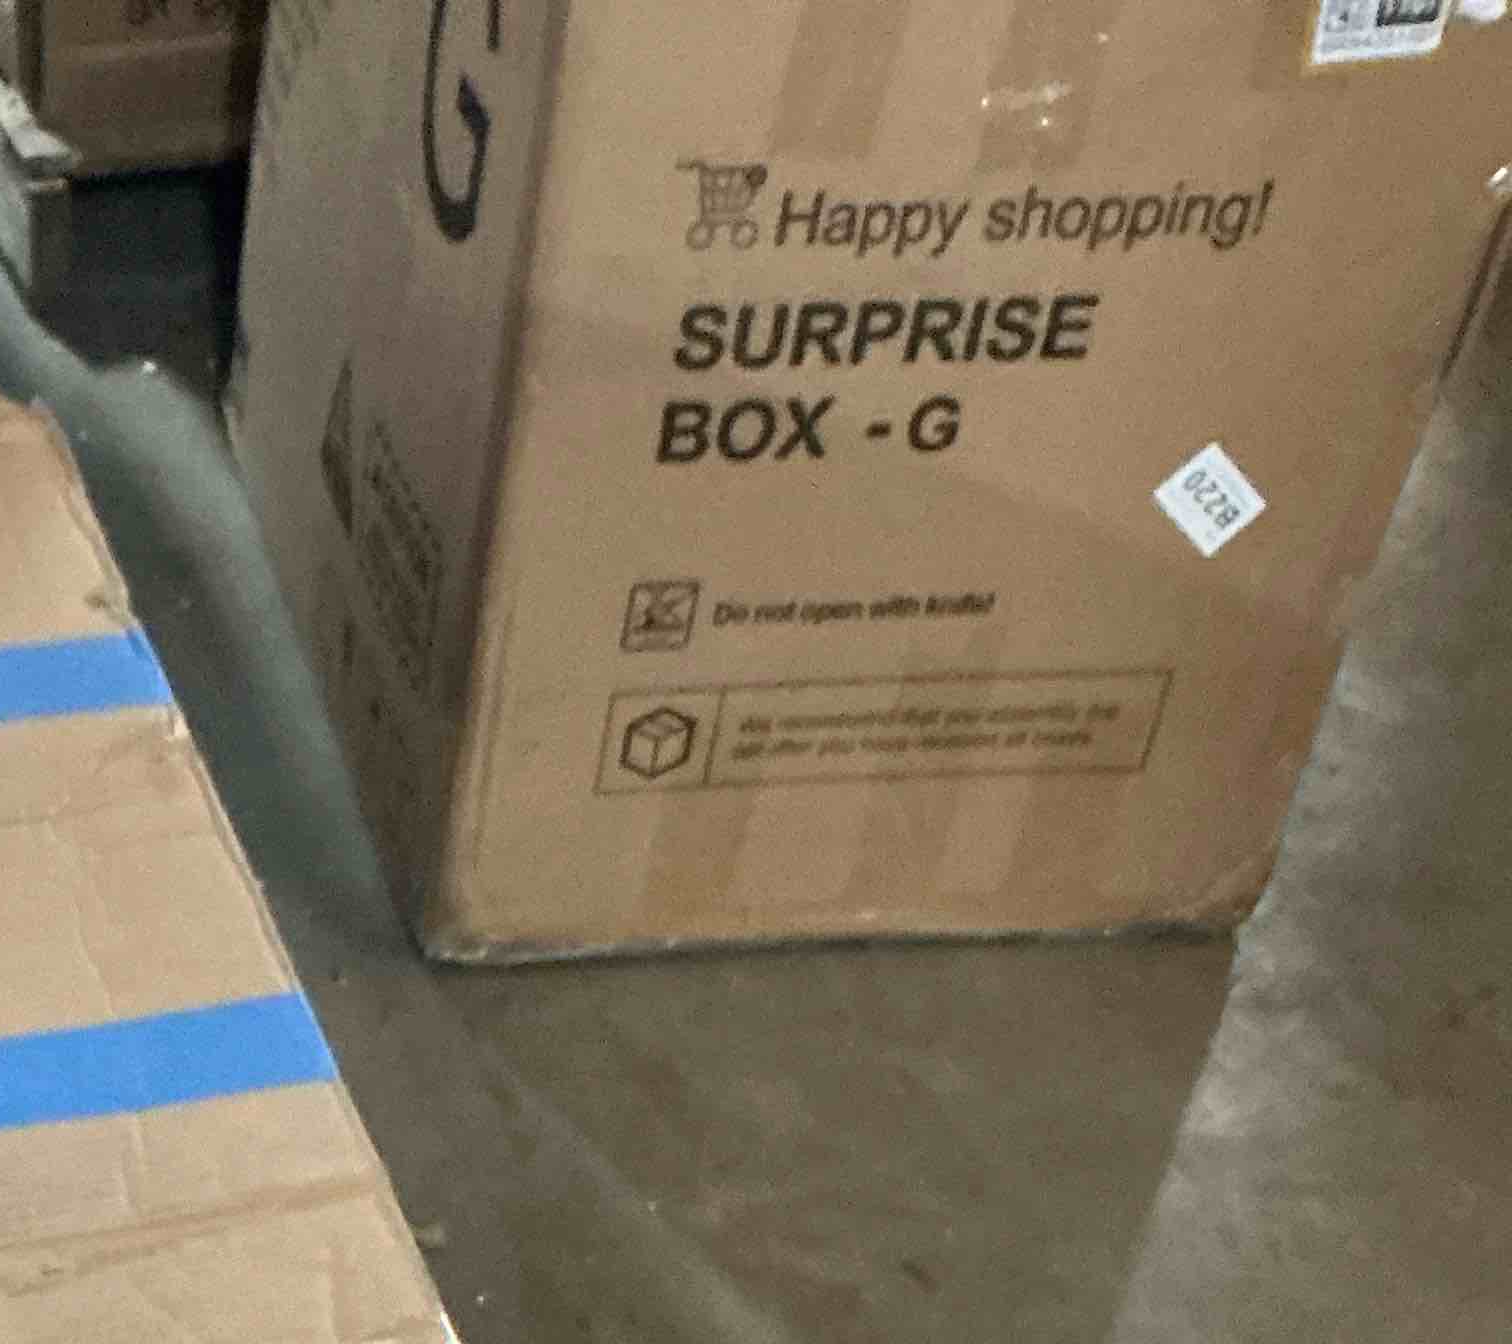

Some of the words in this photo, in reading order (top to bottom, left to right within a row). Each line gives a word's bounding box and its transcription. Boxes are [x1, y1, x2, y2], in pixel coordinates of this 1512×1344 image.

[773, 186, 969, 259] Happy
[982, 176, 1276, 253] shopping!
[672, 293, 1101, 371] SURPRISE
[655, 393, 835, 464] BOX
